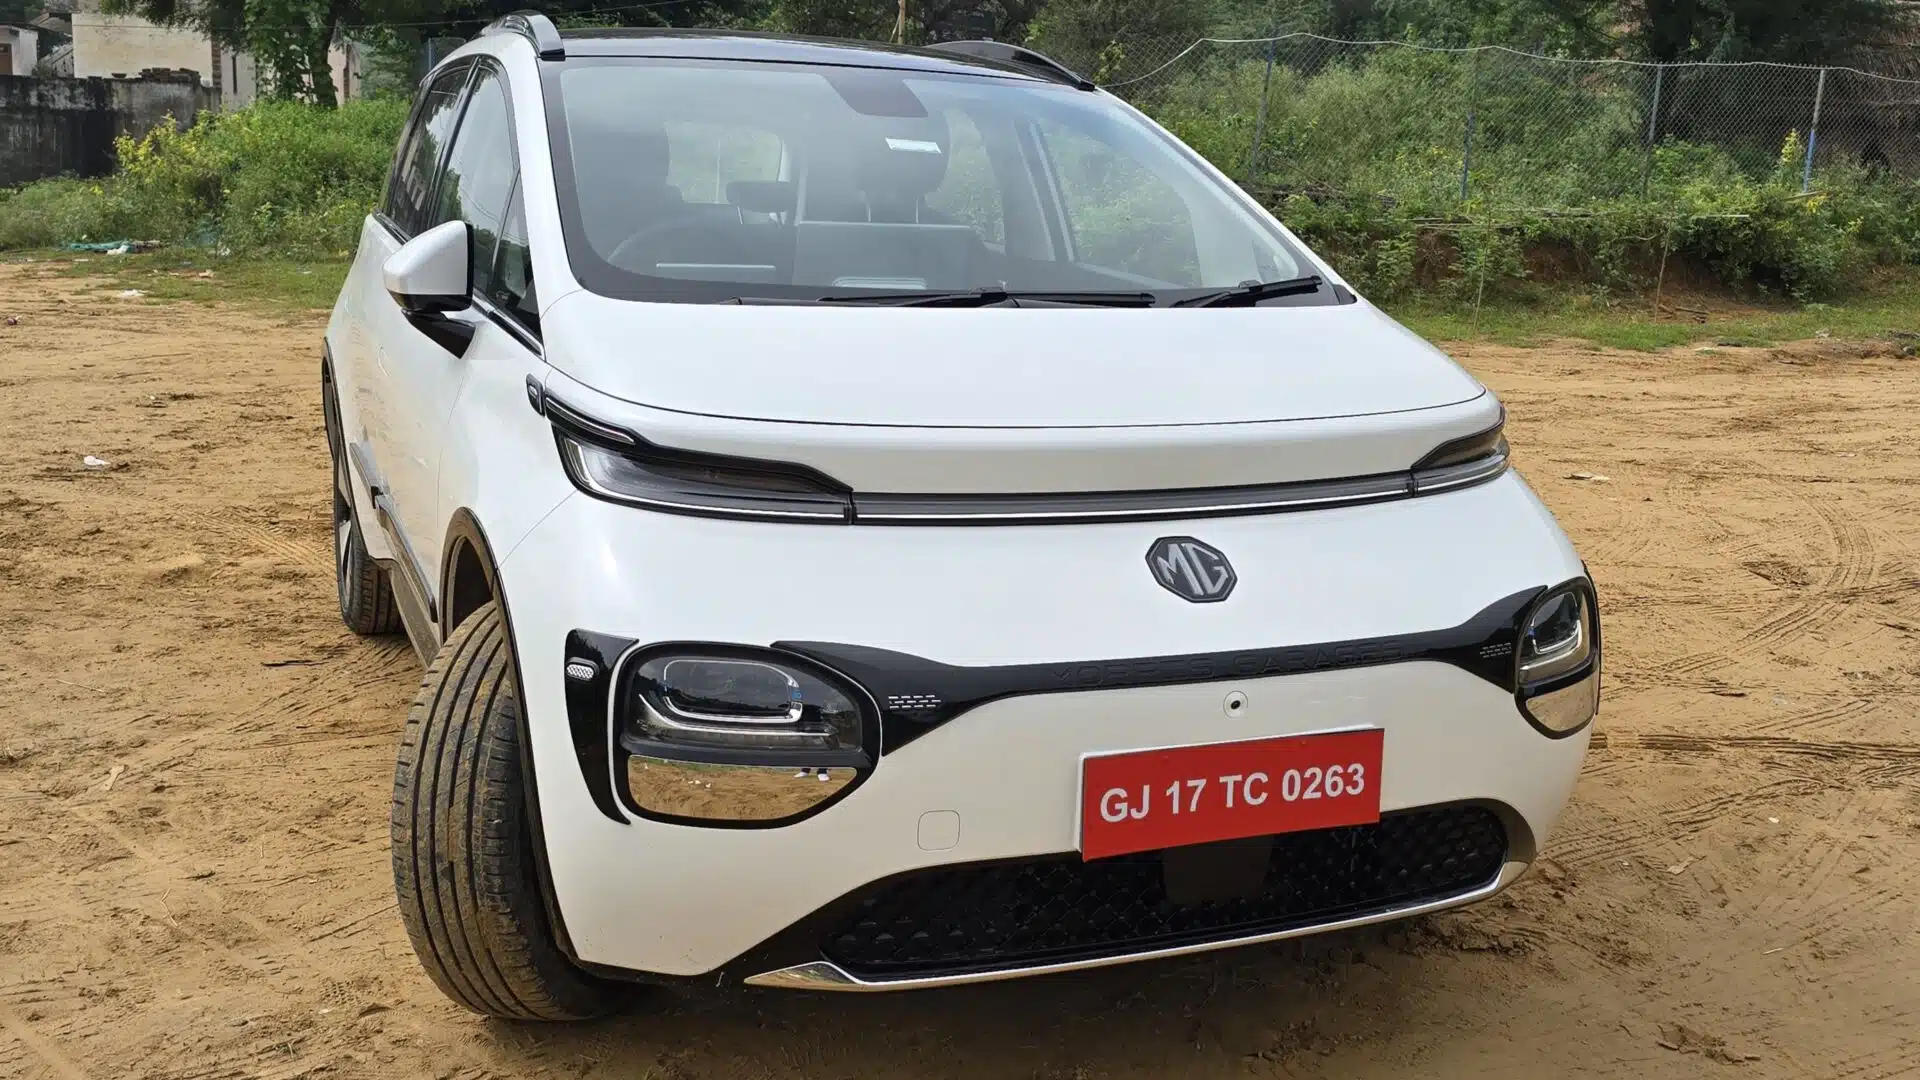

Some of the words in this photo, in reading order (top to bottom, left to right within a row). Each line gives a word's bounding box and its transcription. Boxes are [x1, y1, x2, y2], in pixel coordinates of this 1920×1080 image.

[1157, 543, 1229, 596] MG
[1100, 785, 1150, 823] GJ
[1166, 779, 1207, 814] 17
[1219, 772, 1268, 808] TC
[1282, 763, 1364, 801] 0263
